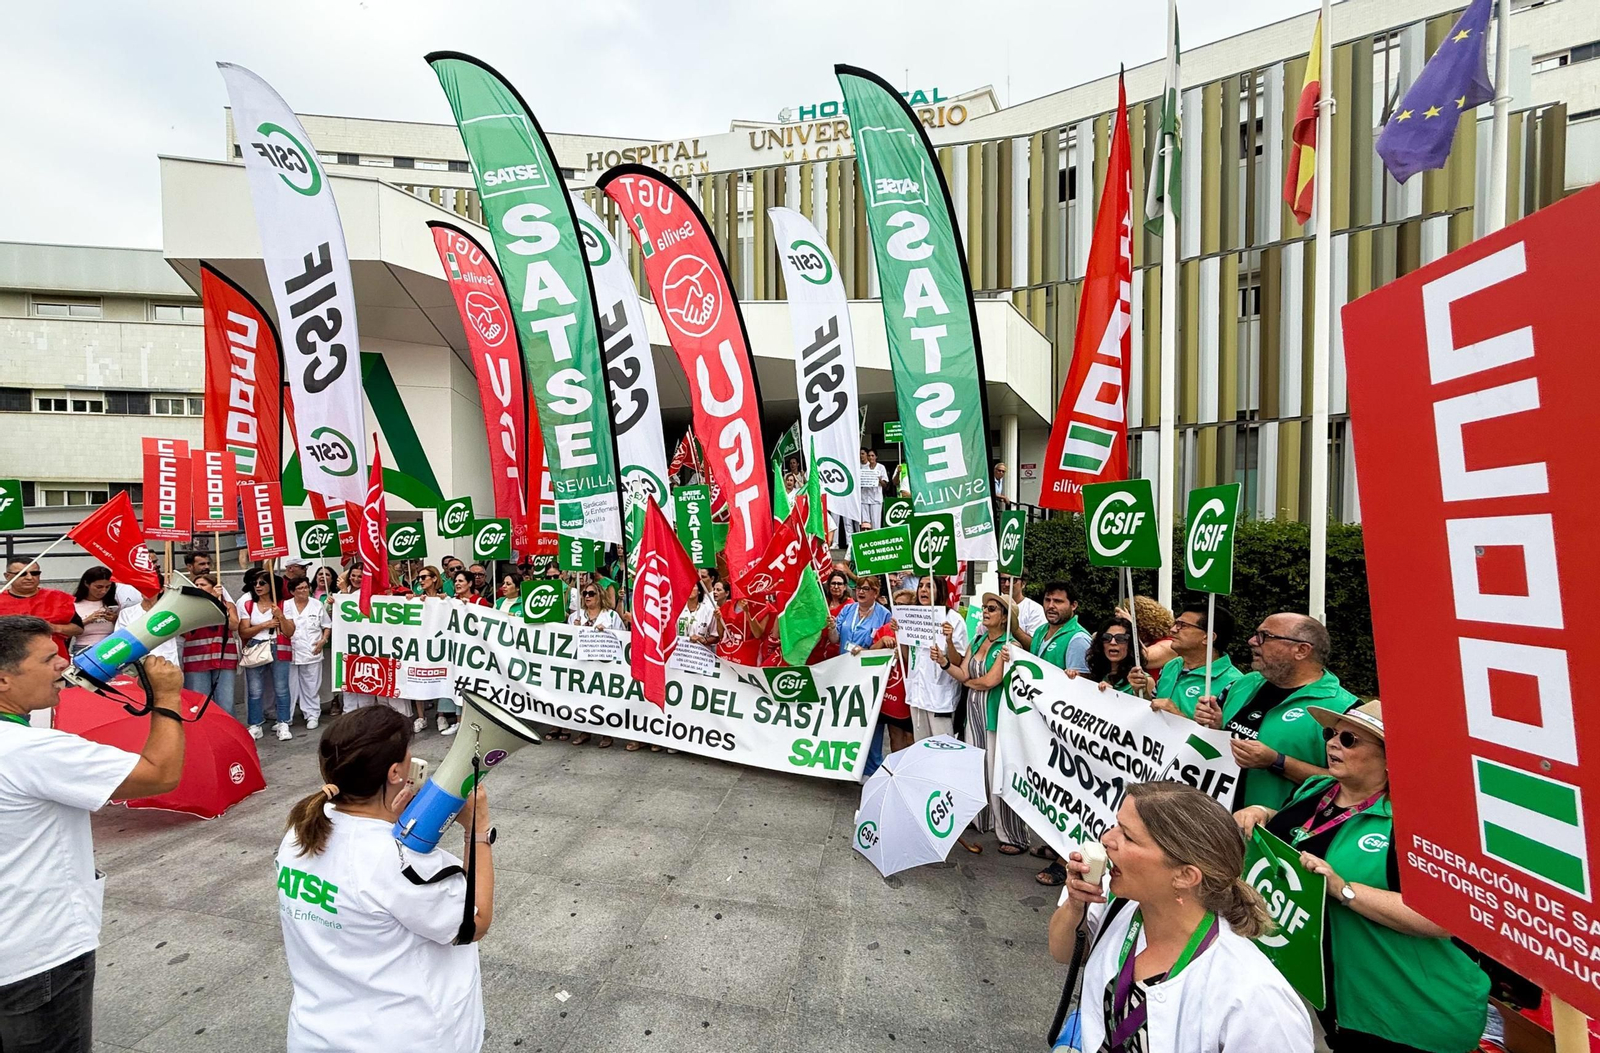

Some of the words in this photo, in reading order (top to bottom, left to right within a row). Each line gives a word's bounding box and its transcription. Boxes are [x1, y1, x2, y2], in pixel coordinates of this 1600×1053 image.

[586, 139, 707, 171] HOSPITAL
[749, 104, 967, 150] UNIVERRIO
[659, 160, 709, 177] RGEN
[783, 143, 855, 162] MACA
[483, 164, 541, 187] SATSE
[502, 203, 598, 469] SATSE
[159, 457, 177, 515] CCOO
[206, 452, 224, 506] CCOO
[556, 474, 614, 493] SEVILLA
[254, 485, 274, 537] CCOO
[449, 510, 469, 524] CSIF
[890, 509, 912, 518] CSIF
[1421, 240, 1579, 767] CCOO
[687, 502, 703, 564] SATSE
[1100, 512, 1145, 535] CSIF
[307, 532, 334, 544] CSIF
[394, 534, 421, 546] CSIF
[480, 532, 506, 545] CSIF
[870, 537, 904, 547] CONSEJERA
[920, 536, 950, 553] CSIF
[1003, 533, 1021, 551] CSIF
[1193, 524, 1228, 552] CSIF
[531, 594, 559, 607] CSIF
[152, 614, 176, 634] SATSE
[101, 641, 127, 660] SATSE
[347, 634, 420, 661] BOLSA
[427, 630, 502, 676] ÚNICA
[508, 657, 542, 687] DE
[550, 665, 683, 706] TRABAO
[691, 684, 743, 719] DEL
[753, 696, 811, 729] SAS
[355, 662, 380, 680] UGT
[779, 678, 808, 690] CSIF
[1051, 700, 1137, 752] COBERTURA
[1142, 733, 1165, 767] DEL
[1228, 721, 1259, 740] ONSEJE
[788, 738, 861, 772] SATS
[1070, 729, 1160, 782] VACACION
[1048, 737, 1127, 812] 100x1
[1012, 772, 1069, 832] LISTADOS
[1027, 766, 1114, 843] CONTRATACI
[1364, 837, 1390, 849] CSIF
[277, 865, 338, 915] ATSE
[1407, 852, 1499, 910] SECTORES
[1412, 834, 1529, 904] FEDERACIÓN
[1535, 892, 1566, 921] DE
[1257, 879, 1311, 934] CSIF
[1469, 904, 1496, 931] DE
